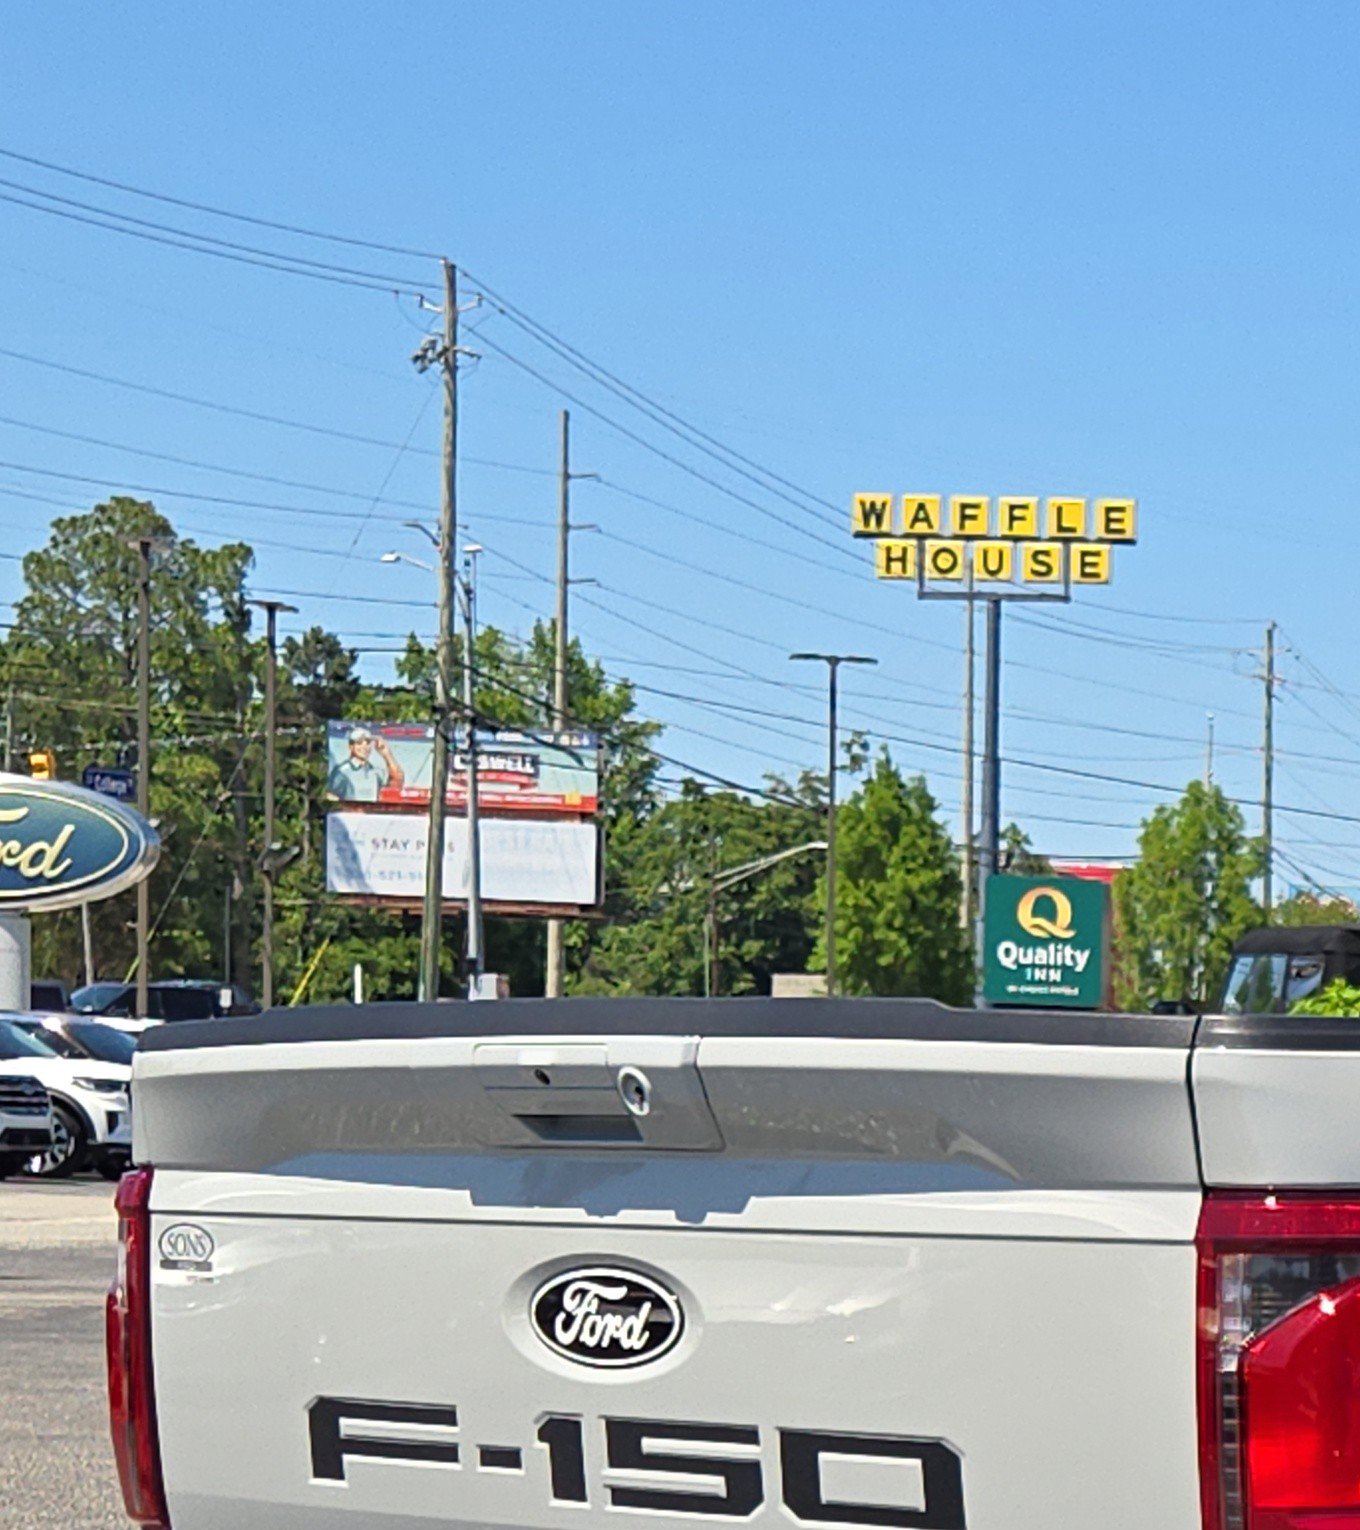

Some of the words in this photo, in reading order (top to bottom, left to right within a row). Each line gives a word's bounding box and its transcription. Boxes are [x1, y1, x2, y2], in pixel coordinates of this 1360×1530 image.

[859, 499, 1127, 535] WAFFLE
[885, 546, 1102, 579] HOUSE
[996, 940, 1091, 973] Quality
[1024, 967, 1062, 983] INN
[555, 1281, 652, 1350] Ford
